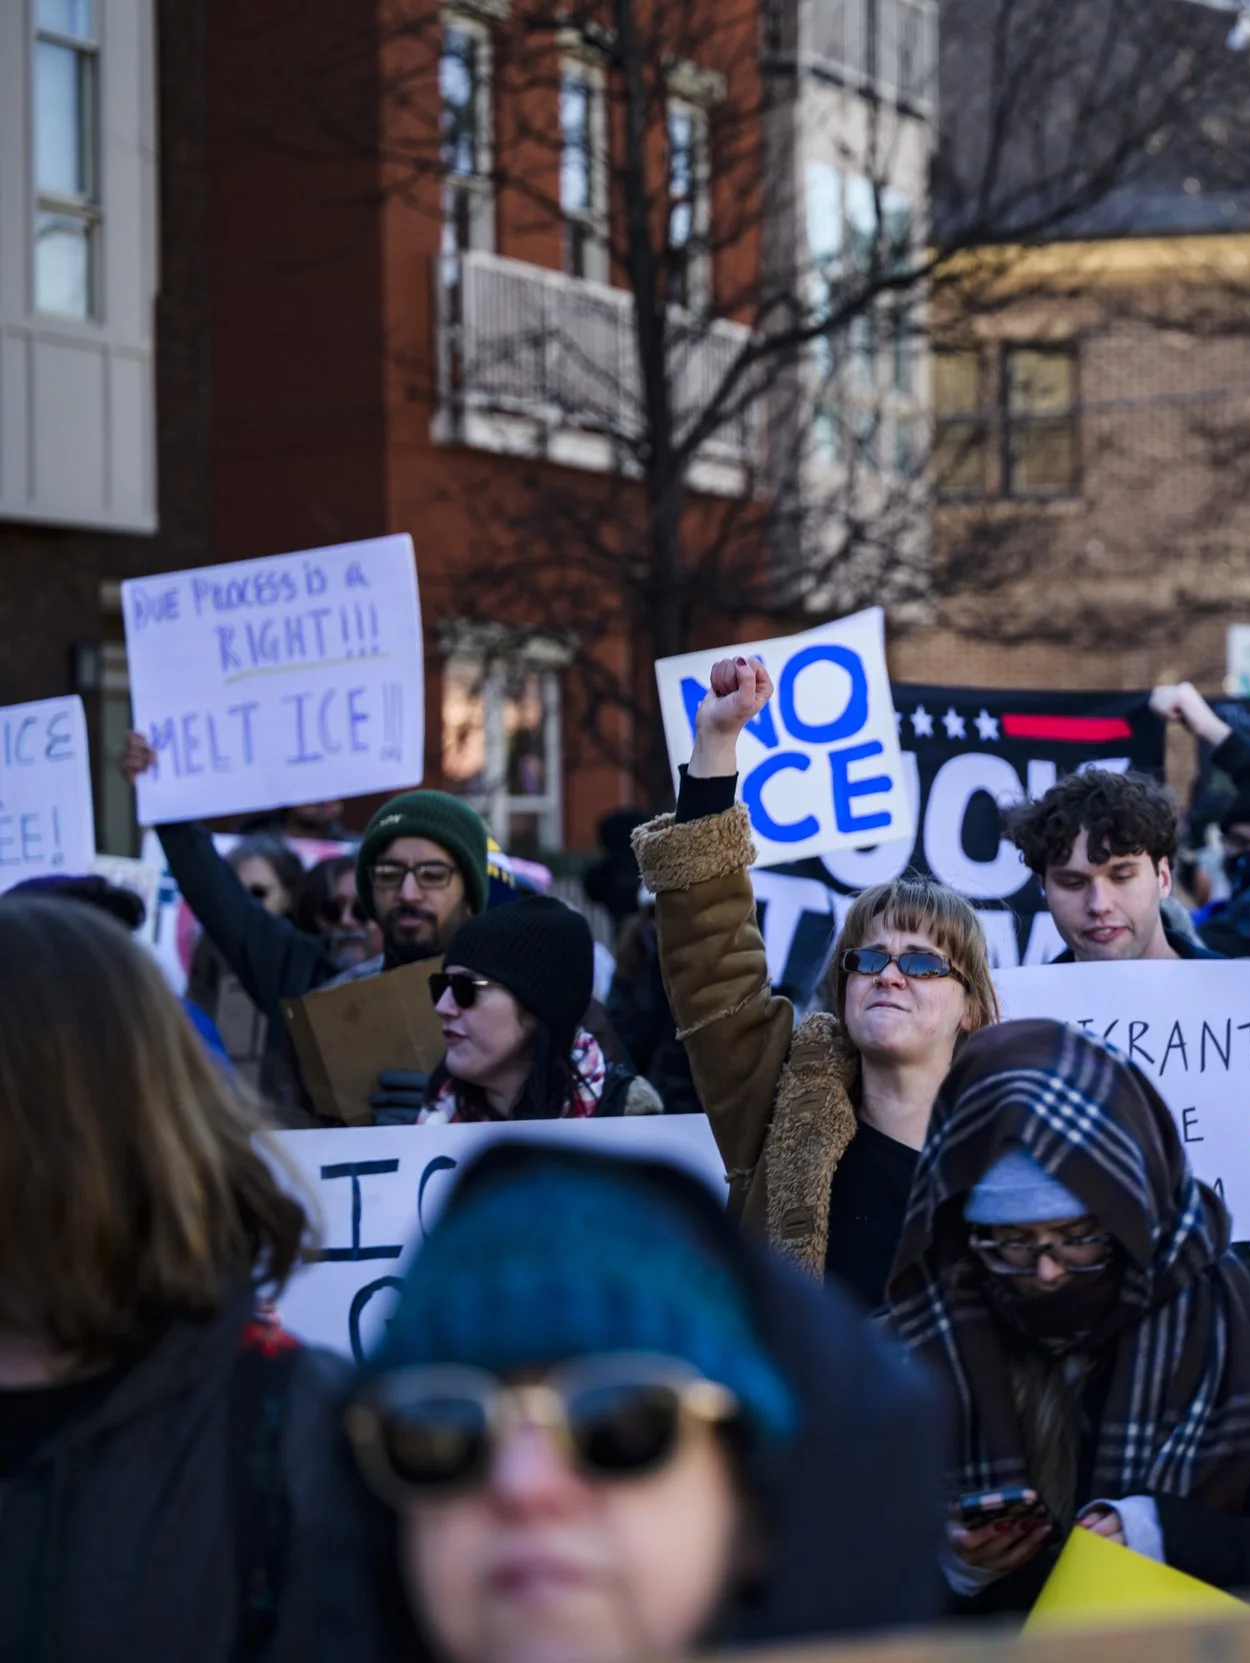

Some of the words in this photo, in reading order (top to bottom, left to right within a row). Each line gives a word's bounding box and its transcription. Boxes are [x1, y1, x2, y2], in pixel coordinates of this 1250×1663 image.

[130, 585, 179, 631] DUE
[216, 601, 380, 671] RIGHT!!!
[151, 701, 258, 781] MELT
[742, 740, 893, 843] CE
